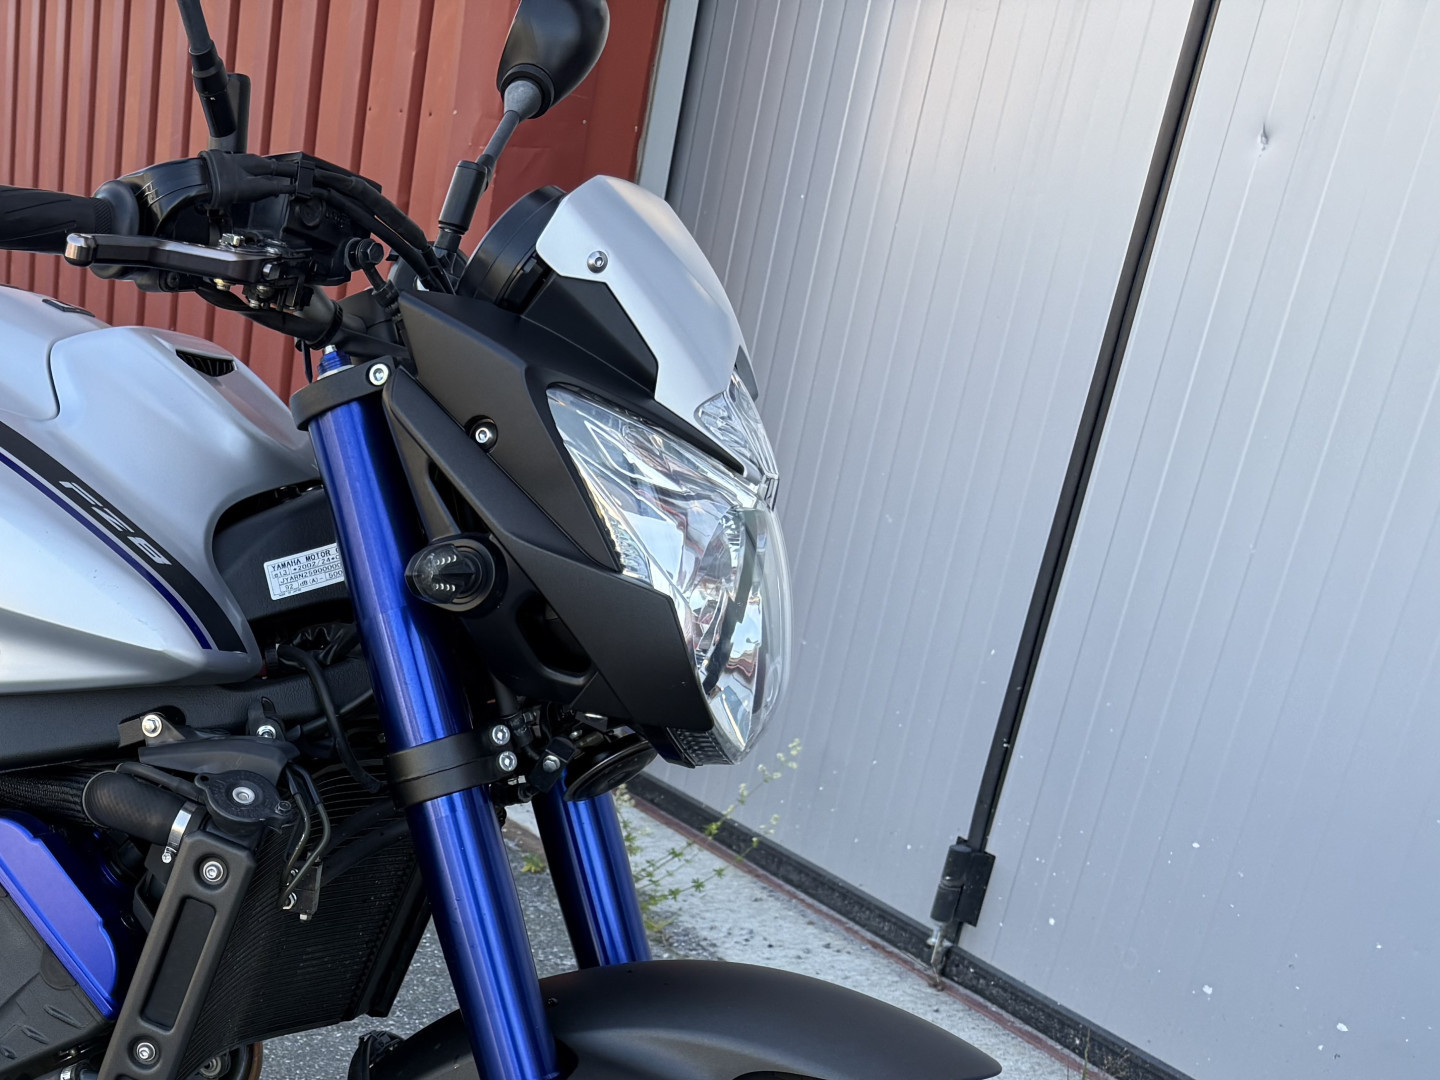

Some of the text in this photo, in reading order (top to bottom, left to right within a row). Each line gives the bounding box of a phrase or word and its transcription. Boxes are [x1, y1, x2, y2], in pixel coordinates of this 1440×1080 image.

[59, 480, 172, 565] FZ8
[272, 558, 302, 571] YAMAHA
[305, 549, 331, 562] MOTOR
